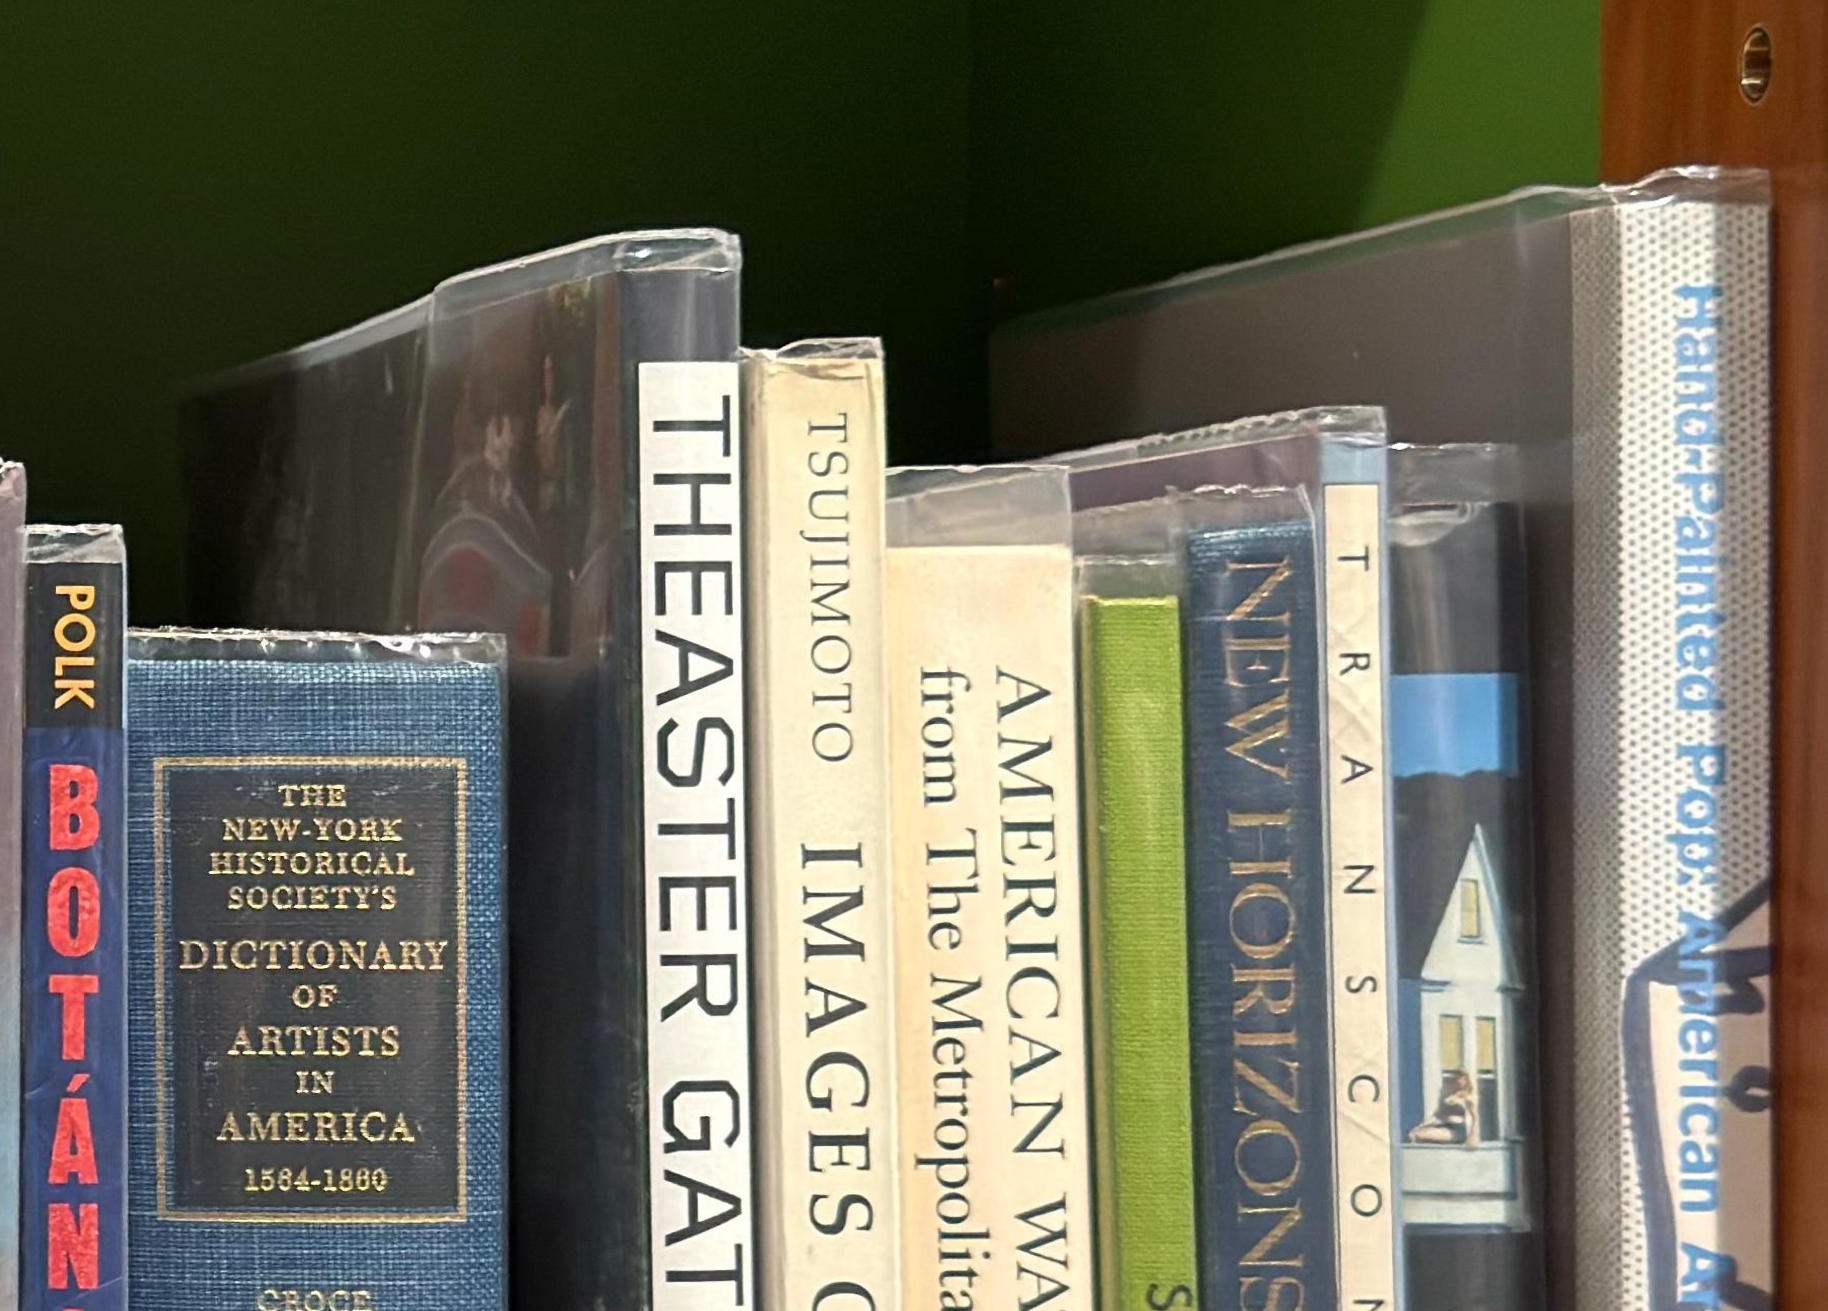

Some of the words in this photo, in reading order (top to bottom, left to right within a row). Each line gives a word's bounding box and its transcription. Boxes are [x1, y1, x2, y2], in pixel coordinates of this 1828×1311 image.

[1674, 286, 1727, 713] Hand-Painted
[55, 586, 95, 709] POLK
[800, 413, 853, 762] TSUJIMOTO
[653, 395, 738, 1022] THEASTER
[921, 668, 971, 806] from
[1225, 559, 1290, 779] NEW
[209, 852, 415, 876] HISTORICAL
[223, 817, 403, 842] NEW-YORK
[926, 828, 979, 949] The
[180, 940, 448, 970] DICTIONARY
[996, 666, 1065, 1158] AMERICAN
[227, 1026, 399, 1056] ARTISTS
[801, 843, 873, 1235] IMAGES
[1677, 912, 1723, 1213] American
[217, 1112, 415, 1142] AMERICA
